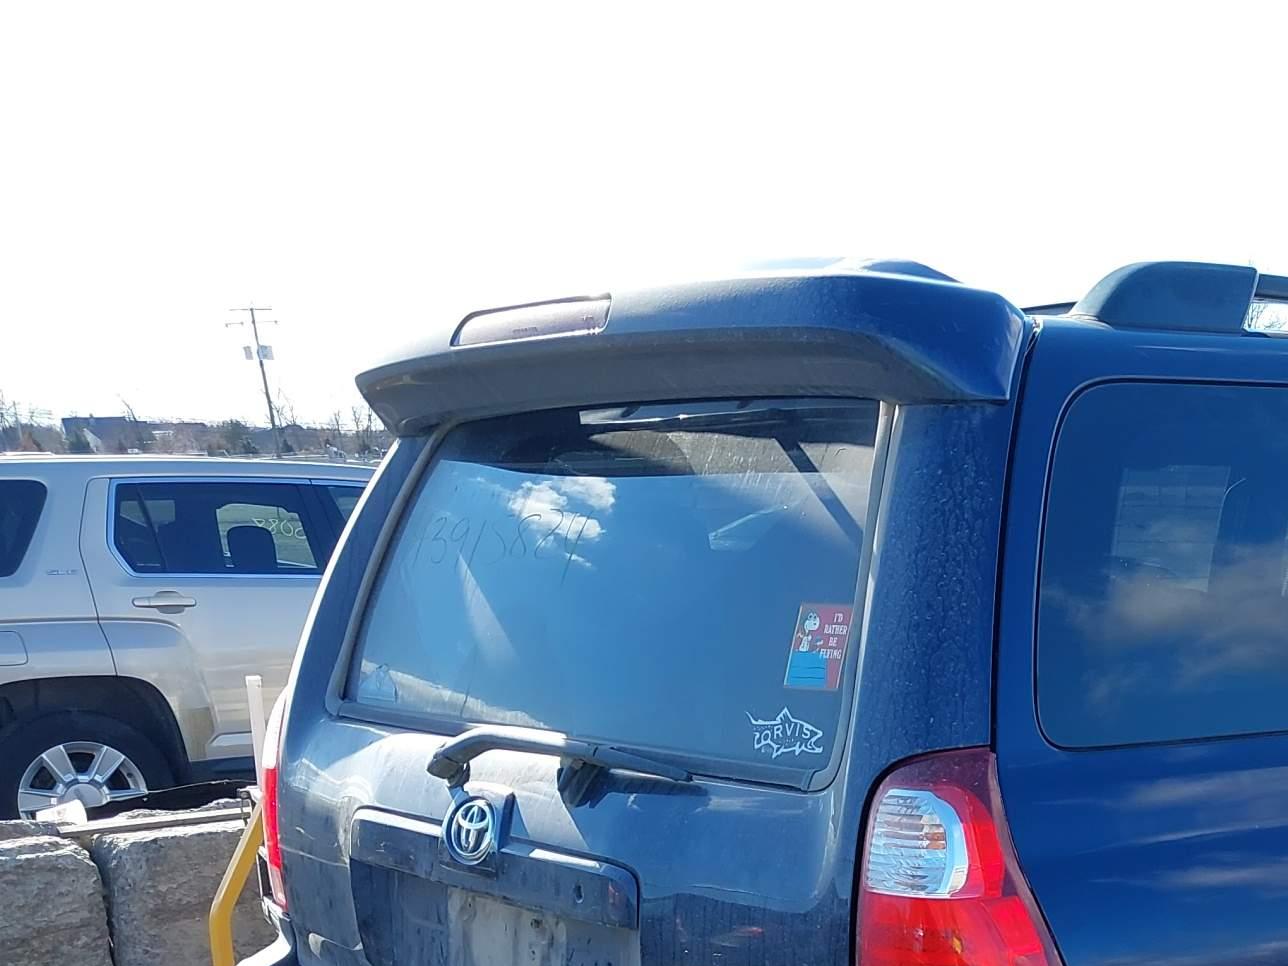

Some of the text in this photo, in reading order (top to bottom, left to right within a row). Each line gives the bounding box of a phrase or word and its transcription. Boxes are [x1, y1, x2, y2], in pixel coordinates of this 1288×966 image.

[823, 624, 848, 635] RATHER
[828, 637, 838, 647] BE
[819, 648, 843, 660] FLYING
[760, 722, 811, 745] ORVIS
